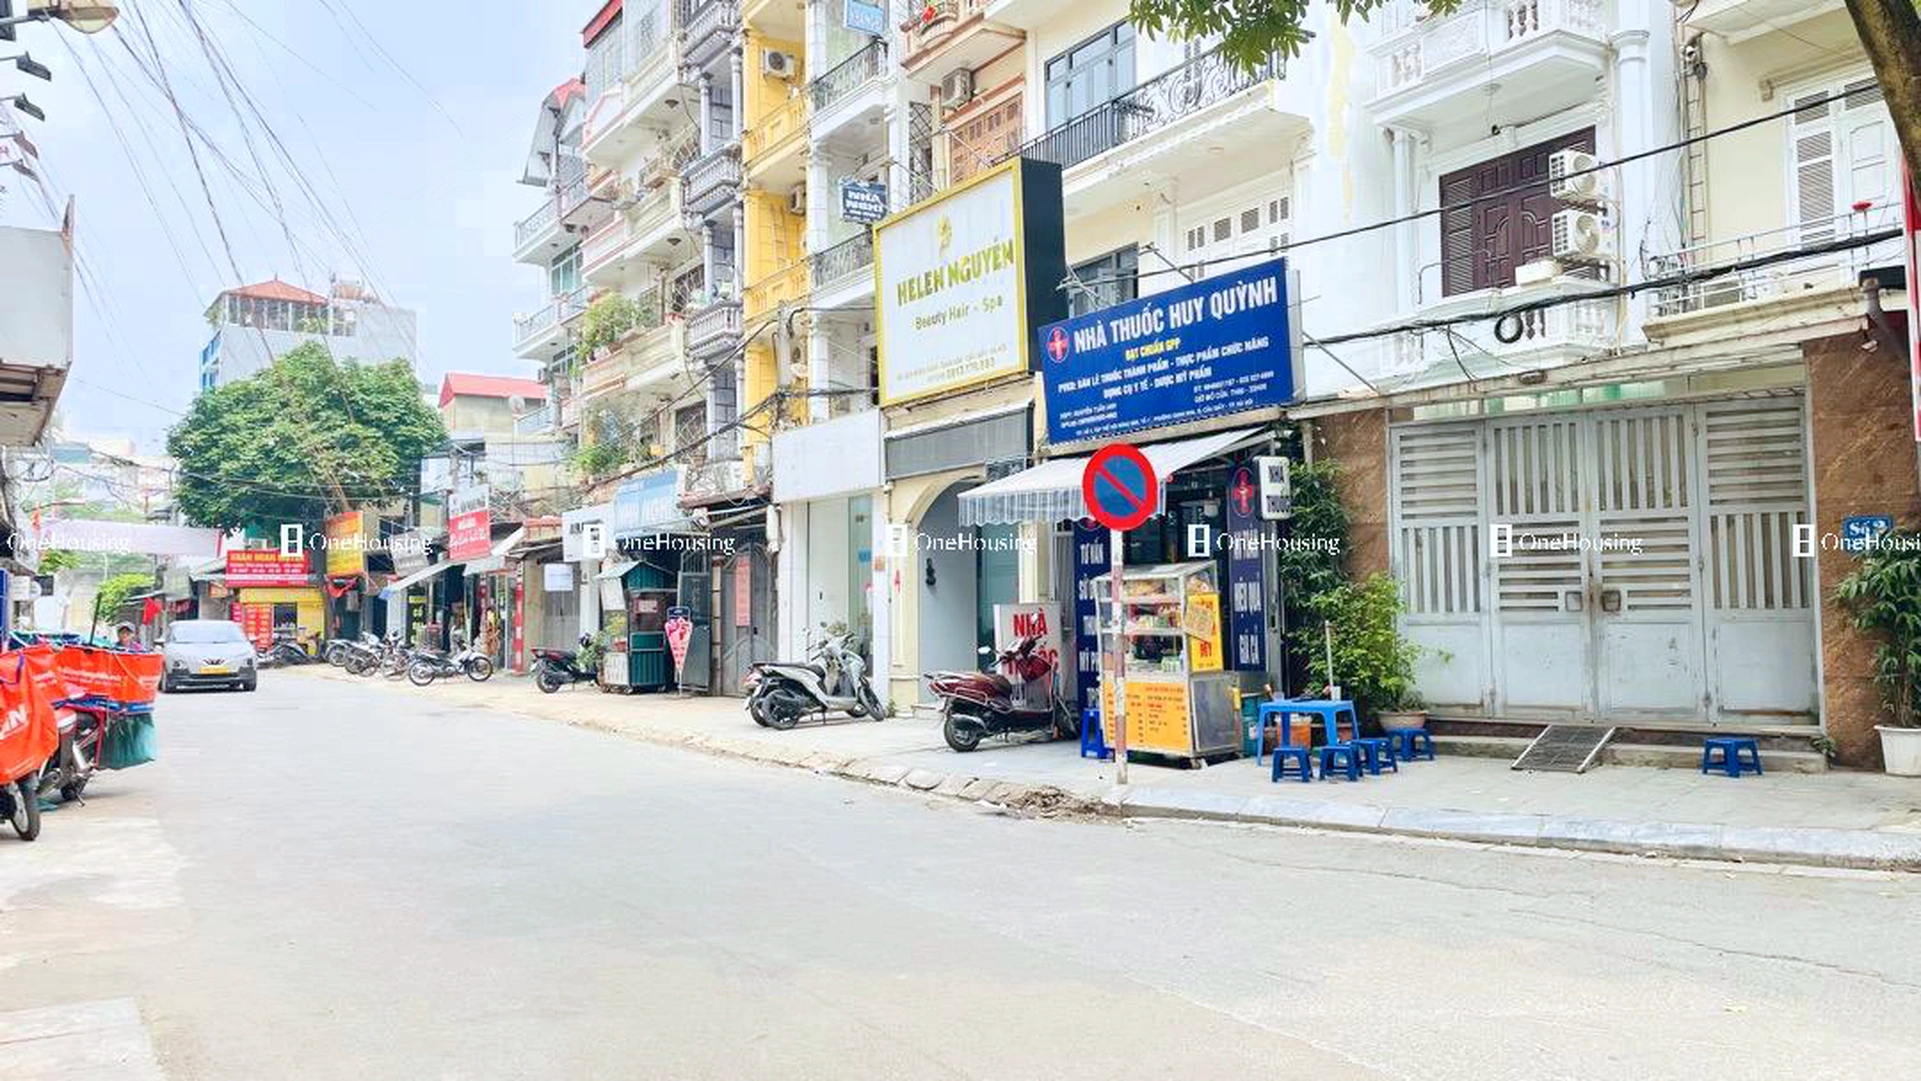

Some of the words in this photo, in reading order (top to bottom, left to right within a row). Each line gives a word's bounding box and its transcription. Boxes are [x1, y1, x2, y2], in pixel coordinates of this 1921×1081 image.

[896, 265, 944, 306] HELEN
[982, 294, 1003, 314] Spa
[1074, 327, 1107, 353] NHÀ
[1110, 302, 1165, 344] THUỐC
[1169, 298, 1204, 330] HUY
[1210, 275, 1278, 322] QUỲNH
[1012, 607, 1047, 637] NHÀ
